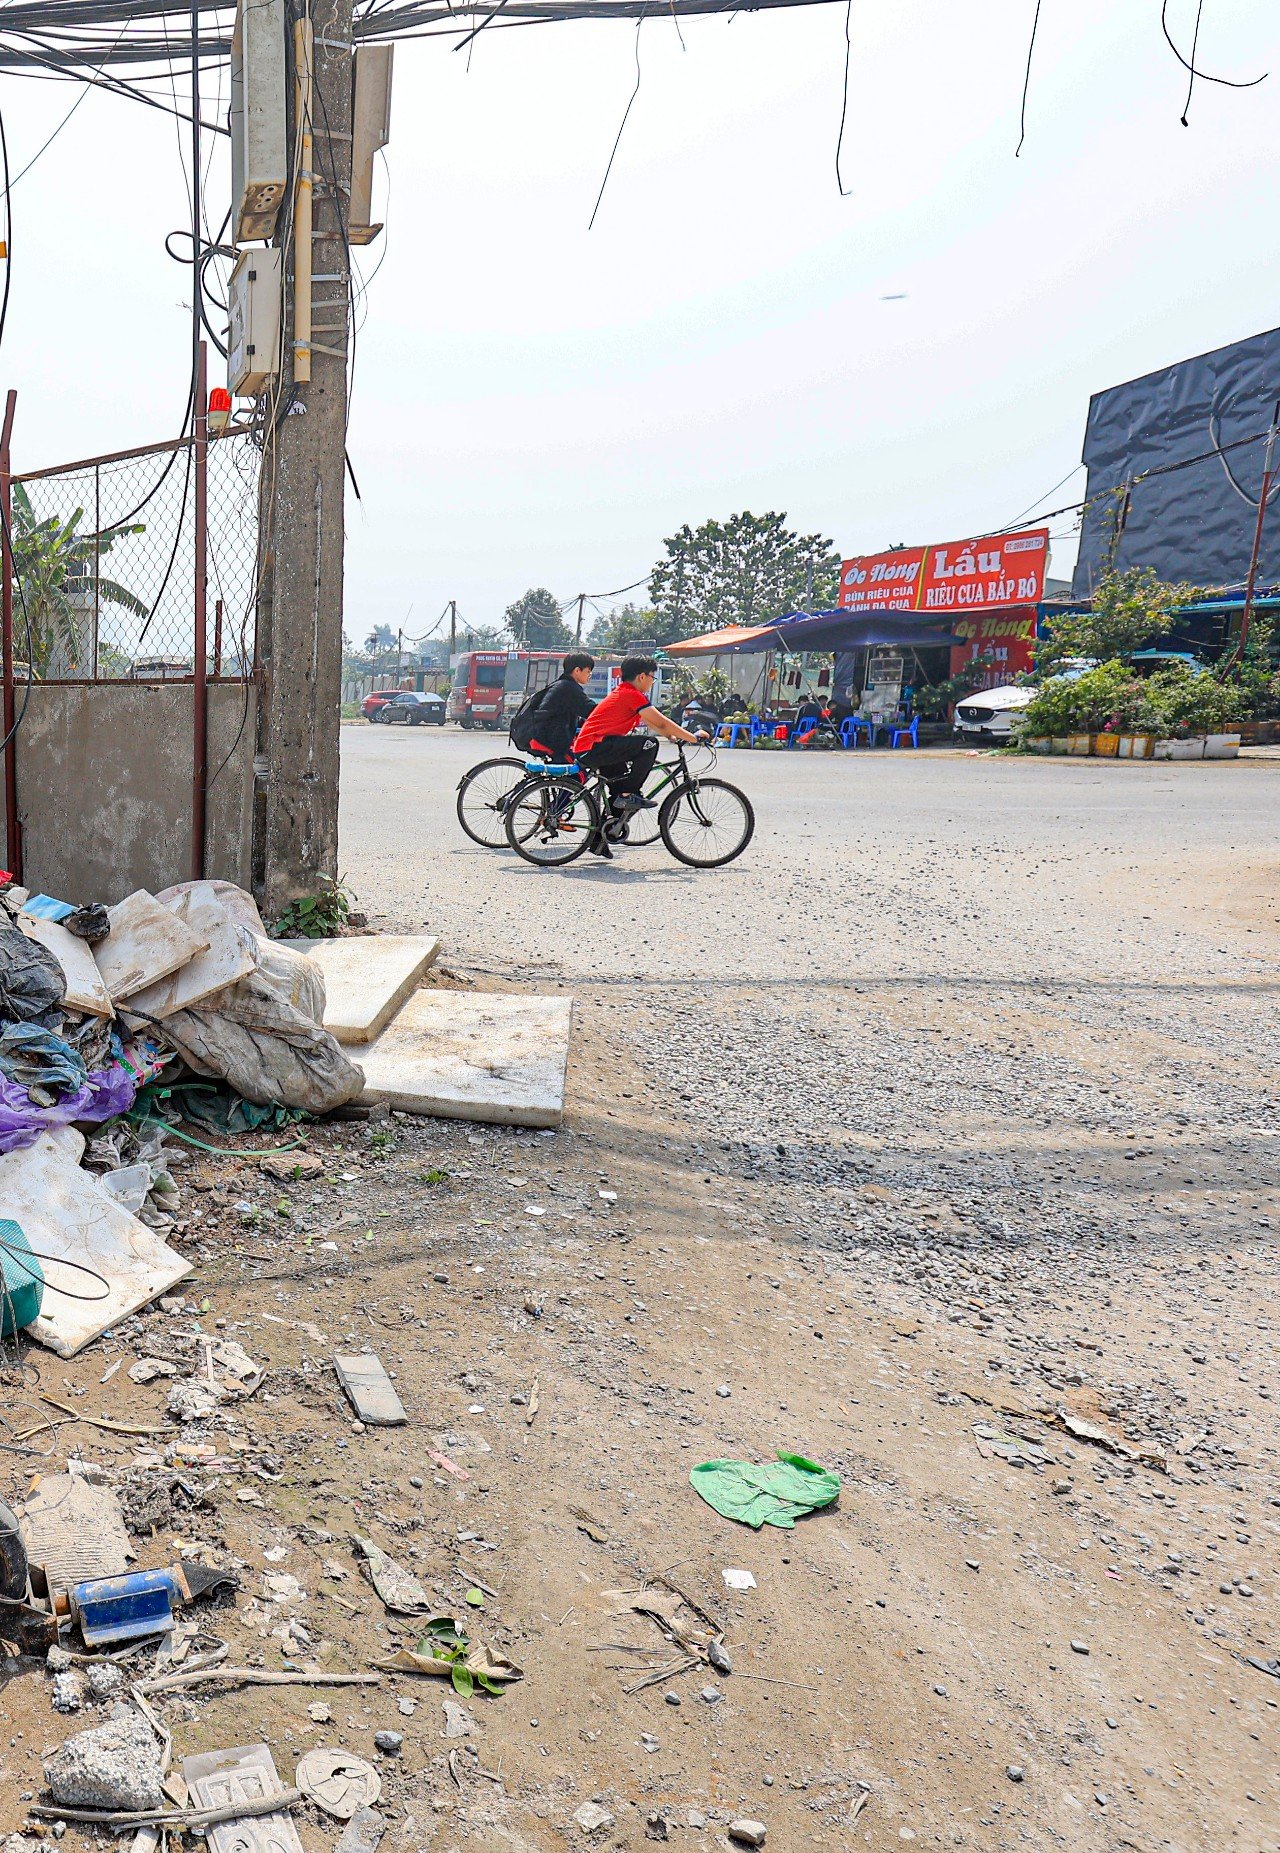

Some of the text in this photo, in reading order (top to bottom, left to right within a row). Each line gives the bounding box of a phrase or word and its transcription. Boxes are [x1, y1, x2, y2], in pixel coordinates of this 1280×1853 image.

[844, 559, 921, 586] Ốc Nóng
[933, 541, 1001, 579] Lẩu
[844, 590, 865, 603] BÚN
[892, 585, 914, 597] CUA
[925, 568, 1038, 608] RIÊU CUA BẮP BÒ
[888, 598, 910, 610] CUA
